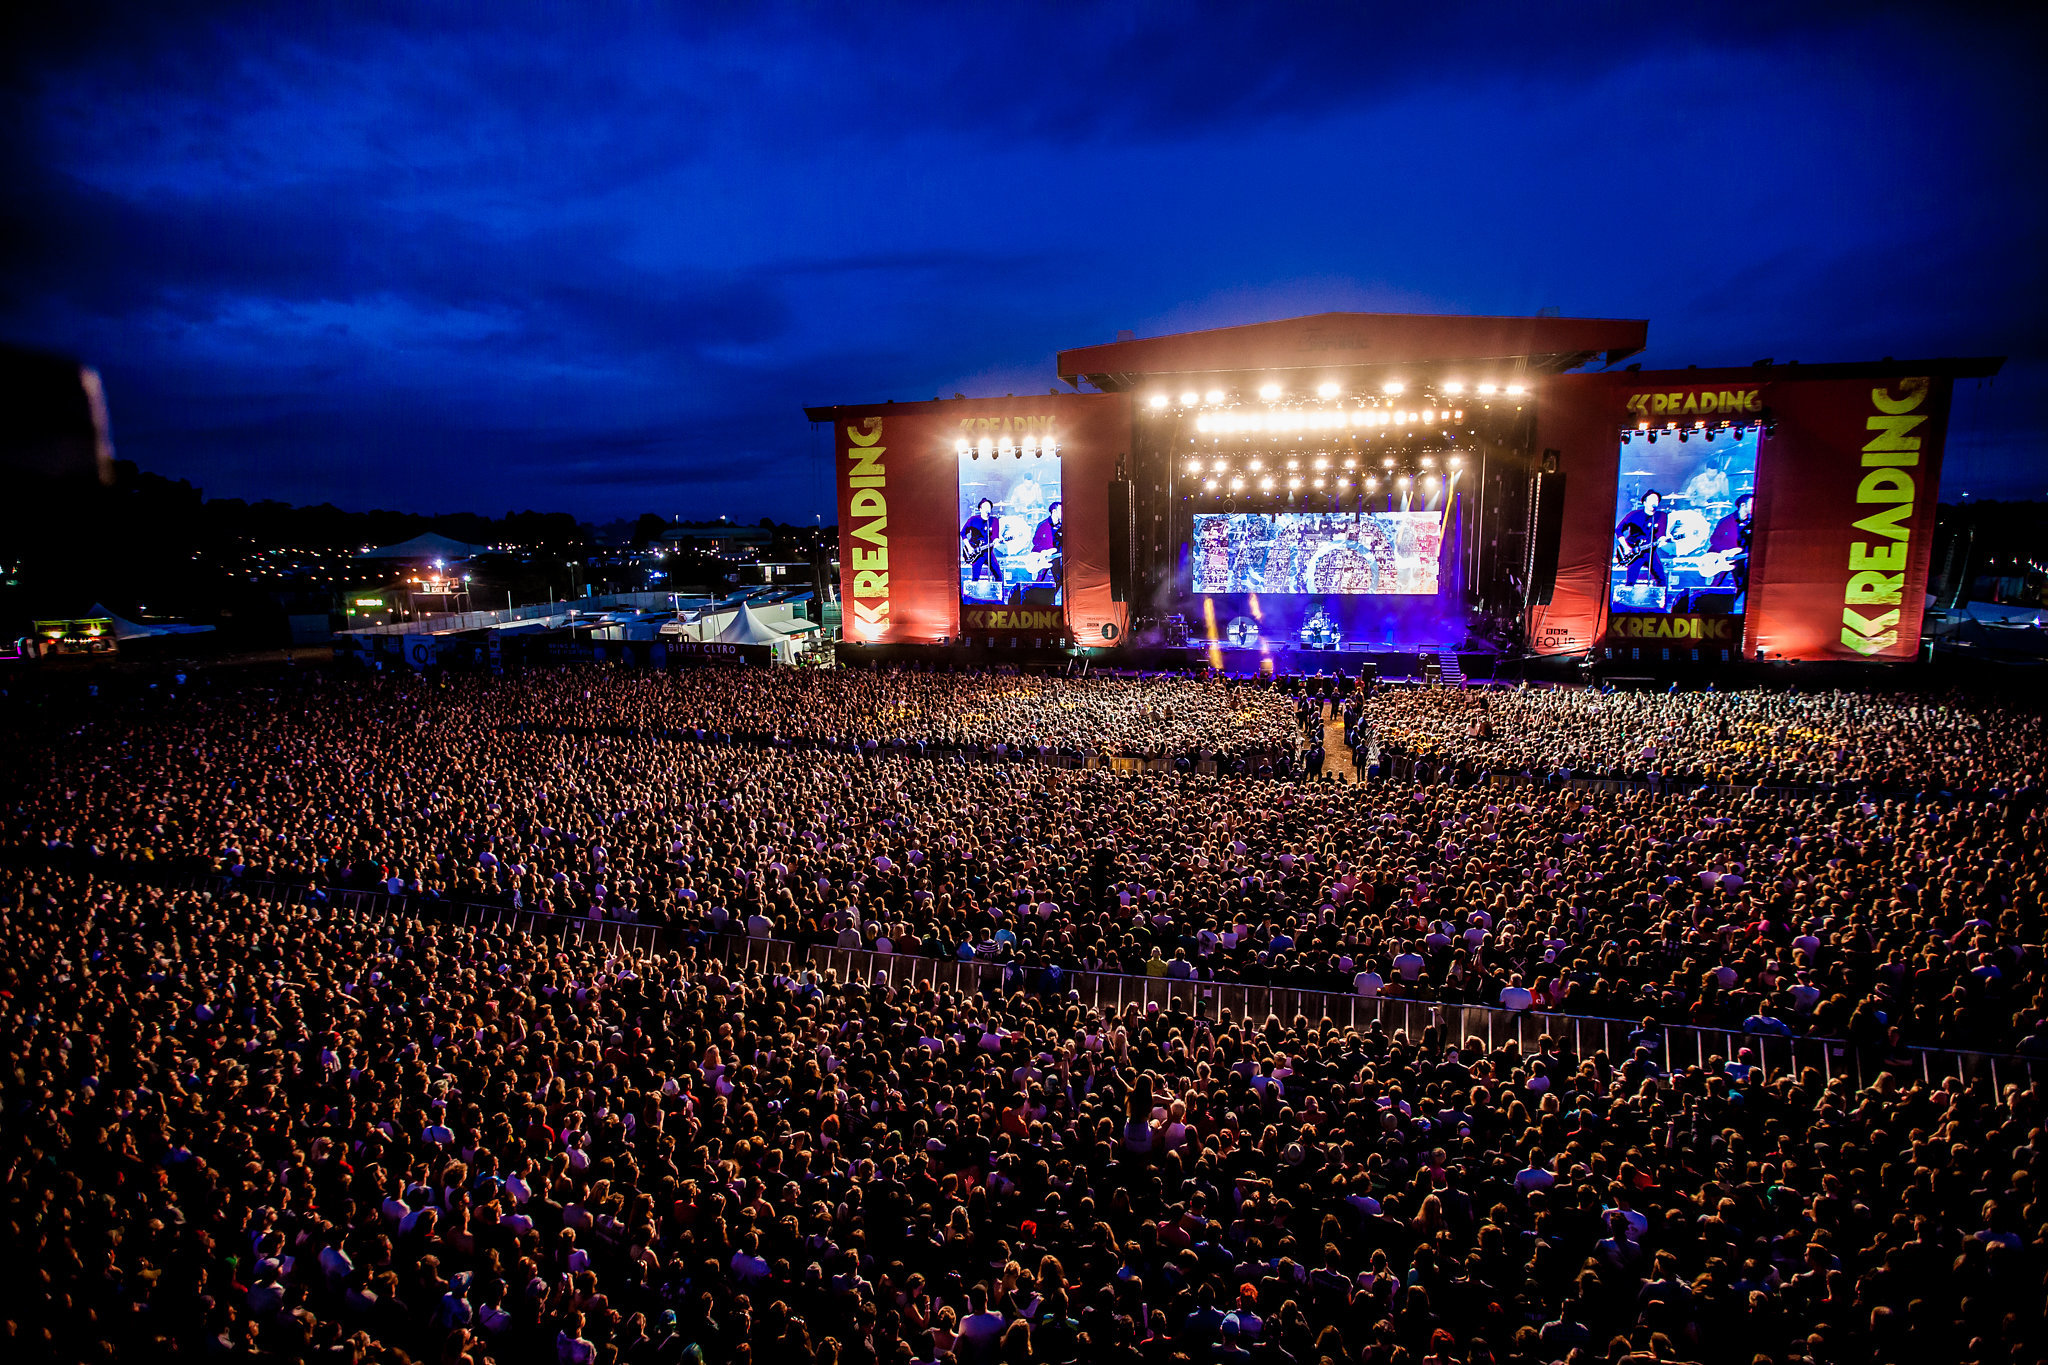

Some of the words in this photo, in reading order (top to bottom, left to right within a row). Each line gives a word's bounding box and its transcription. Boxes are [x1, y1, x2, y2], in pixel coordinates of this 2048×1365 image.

[1651, 390, 1763, 415] READING
[1845, 376, 1930, 604] READING
[847, 416, 890, 598] READING
[1627, 617, 1733, 639] READING
[668, 643, 697, 653] BIFFY
[703, 644, 736, 654] CLYRO
